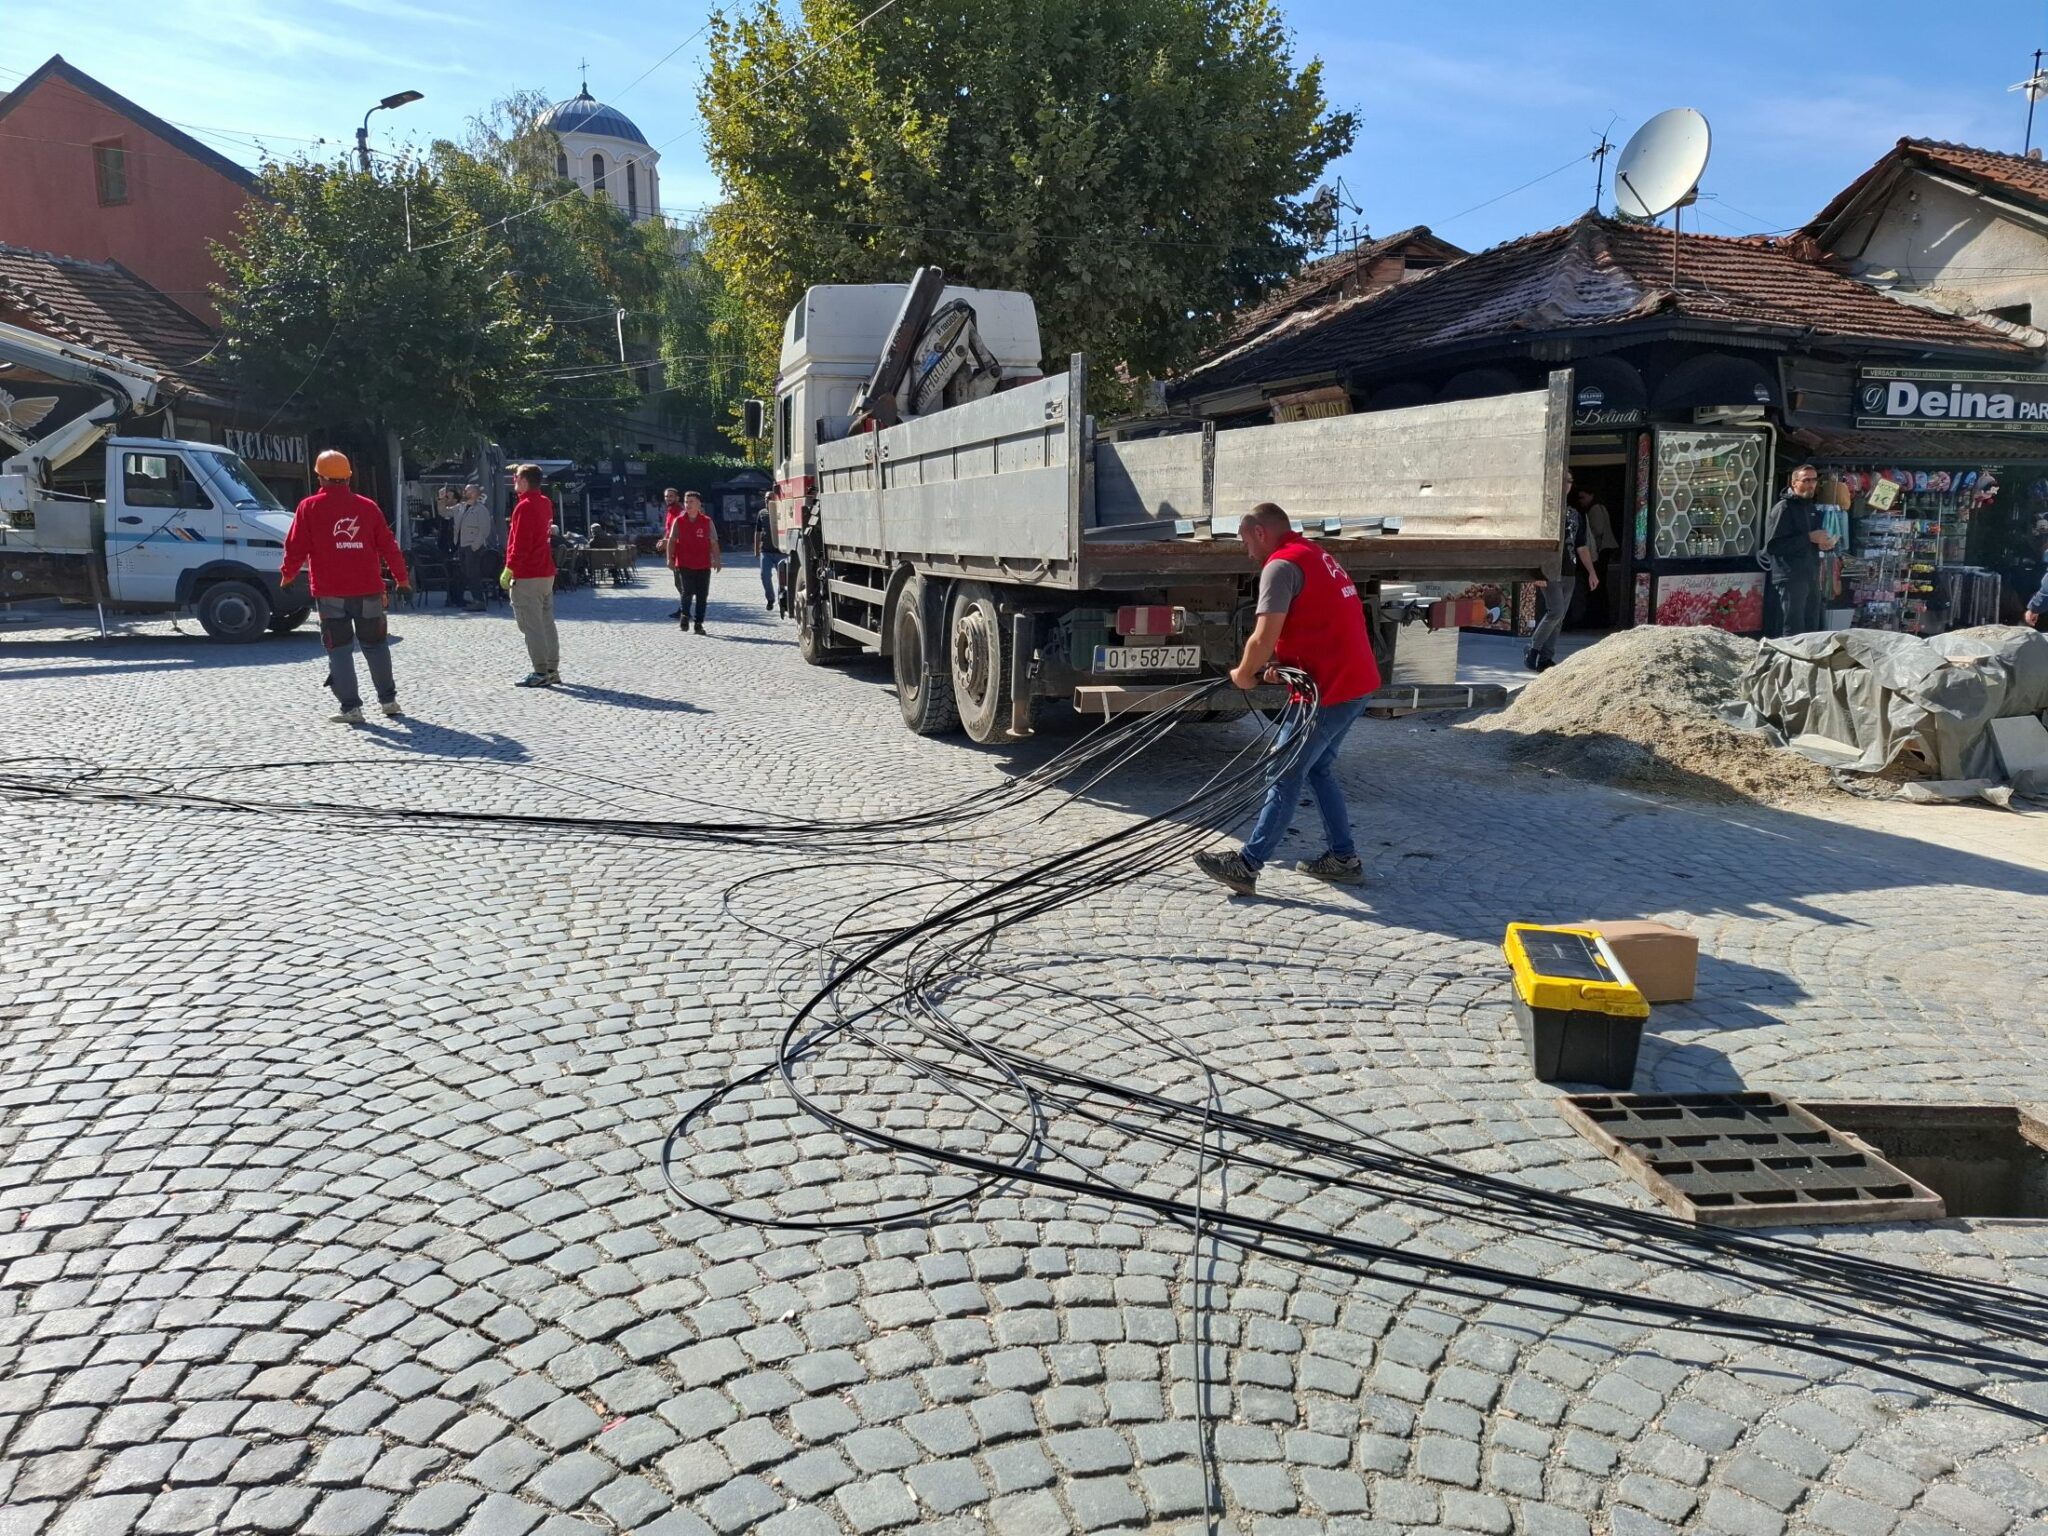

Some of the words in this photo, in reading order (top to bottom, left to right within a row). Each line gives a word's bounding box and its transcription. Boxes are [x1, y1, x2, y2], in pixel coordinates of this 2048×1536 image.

[1886, 381, 2014, 419] Deina
[2018, 401, 2048, 420] PAR
[1574, 408, 1640, 426] Belindi
[224, 429, 304, 463] EXCLUSIVE
[1109, 649, 1128, 668] 01
